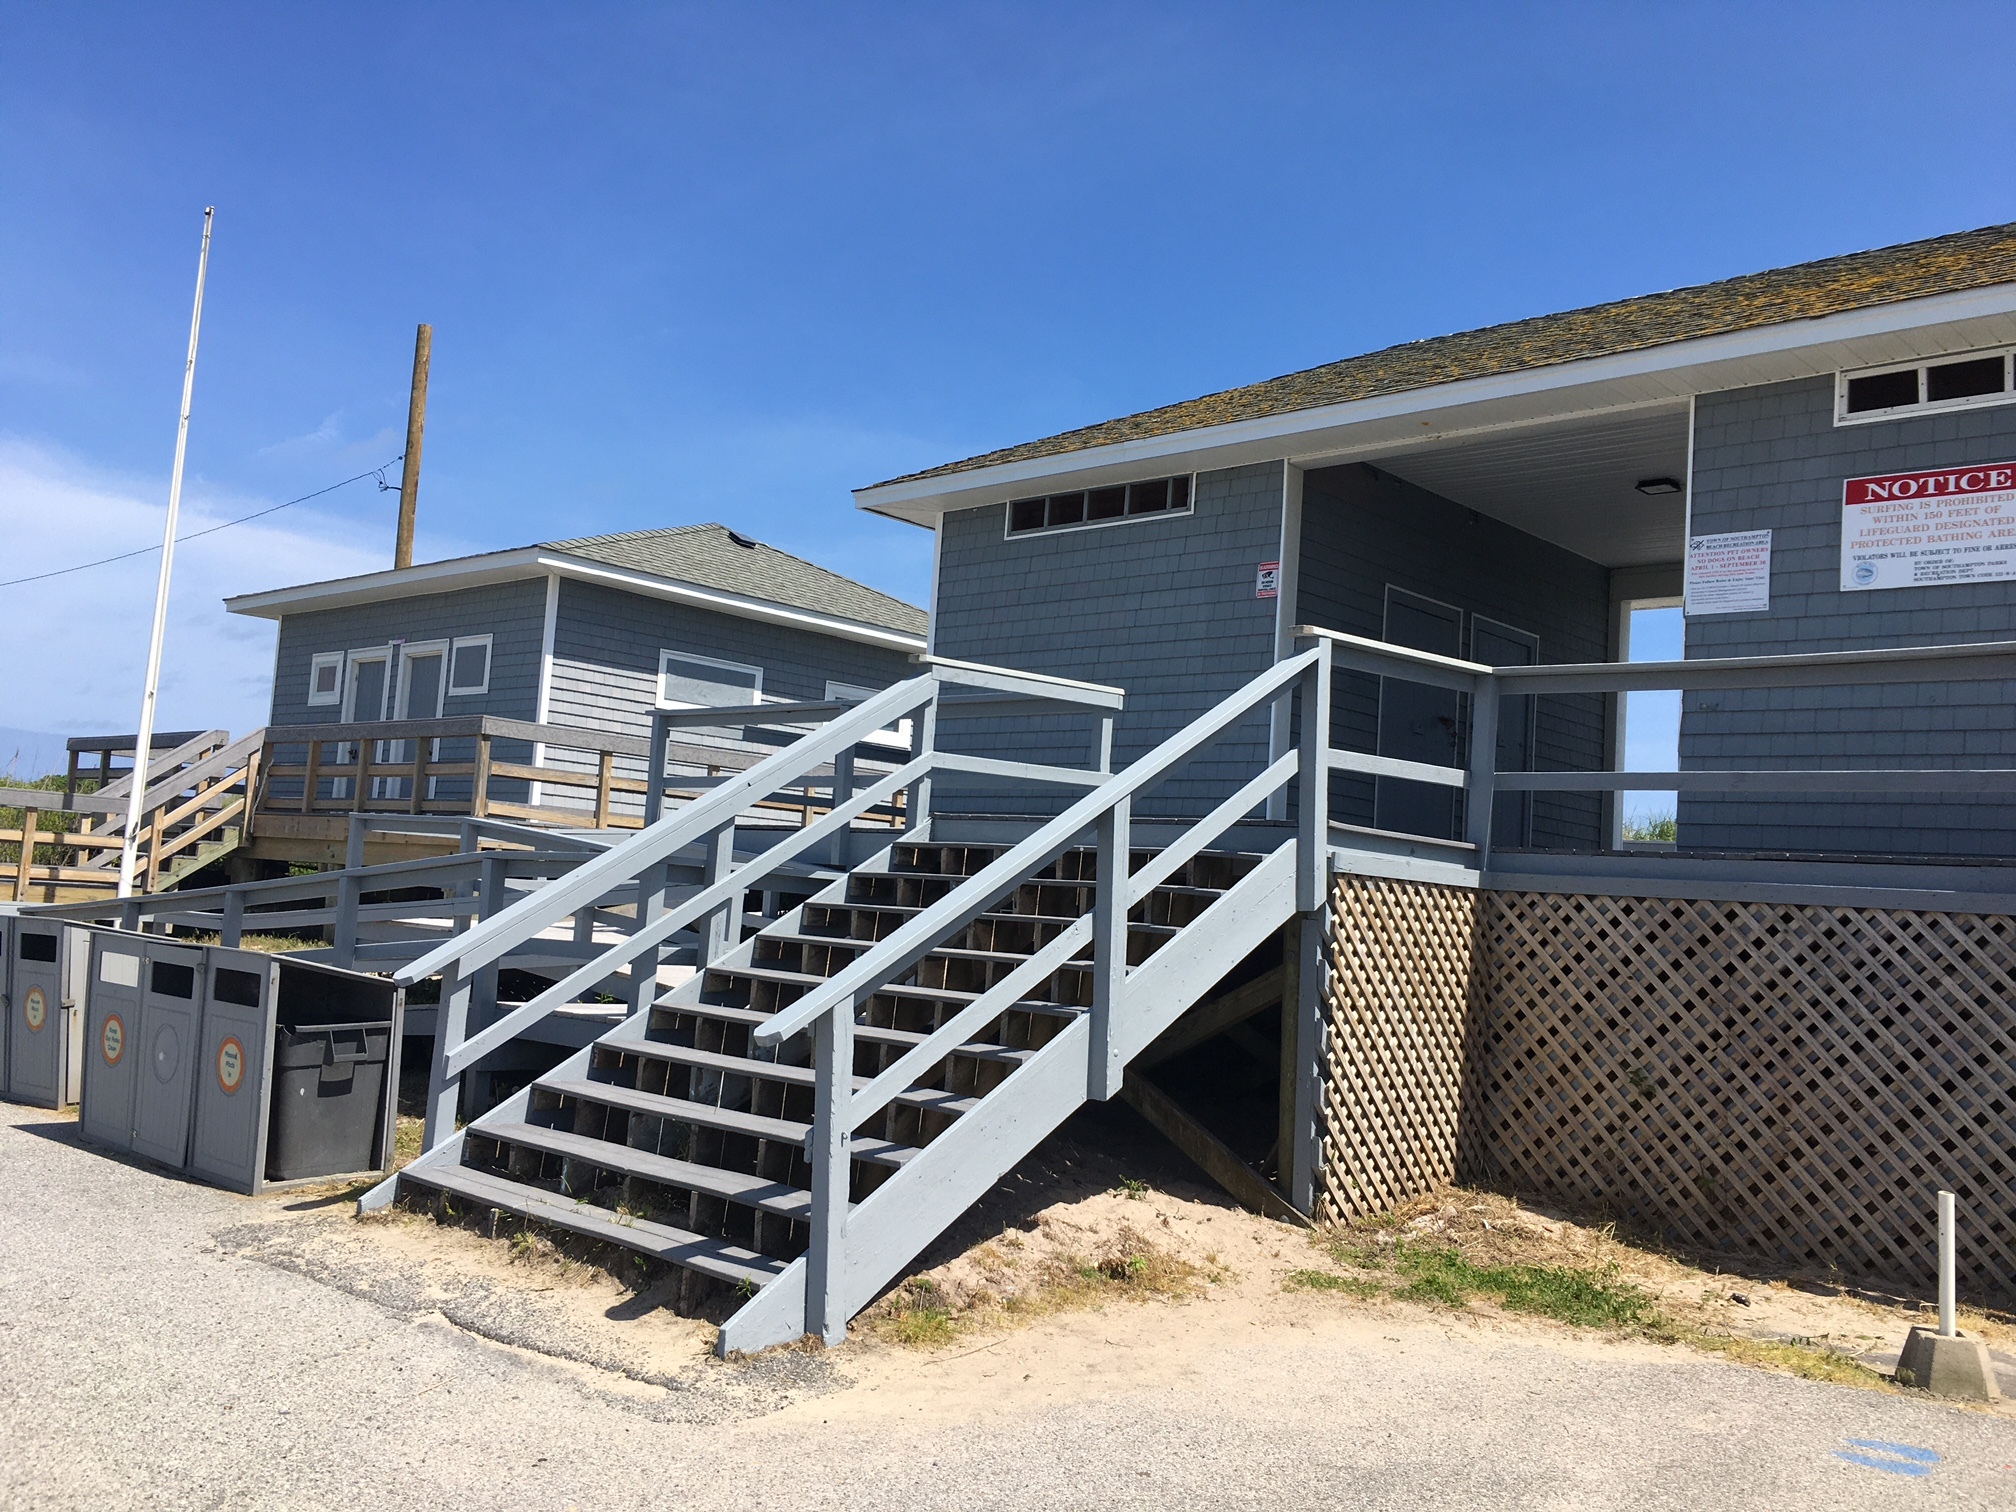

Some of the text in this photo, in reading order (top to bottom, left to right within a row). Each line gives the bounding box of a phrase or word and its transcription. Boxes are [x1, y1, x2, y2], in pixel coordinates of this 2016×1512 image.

[1864, 469, 2012, 500] NOTICE
[1860, 493, 2015, 515] SURFING IS PROHIBITED
[1872, 505, 2002, 524] WITHIN 150 FEET OF
[1859, 516, 2015, 537] LIFEGUARD DESIGNATED
[1850, 527, 2016, 550] PROTECTED BATHING ARE
[1689, 551, 1725, 559] ATTENTION
[1720, 561, 1758, 569] SEPTEMBER
[1852, 553, 1888, 561] VIOLATORS
[1920, 549, 1950, 557] SUBJECT
